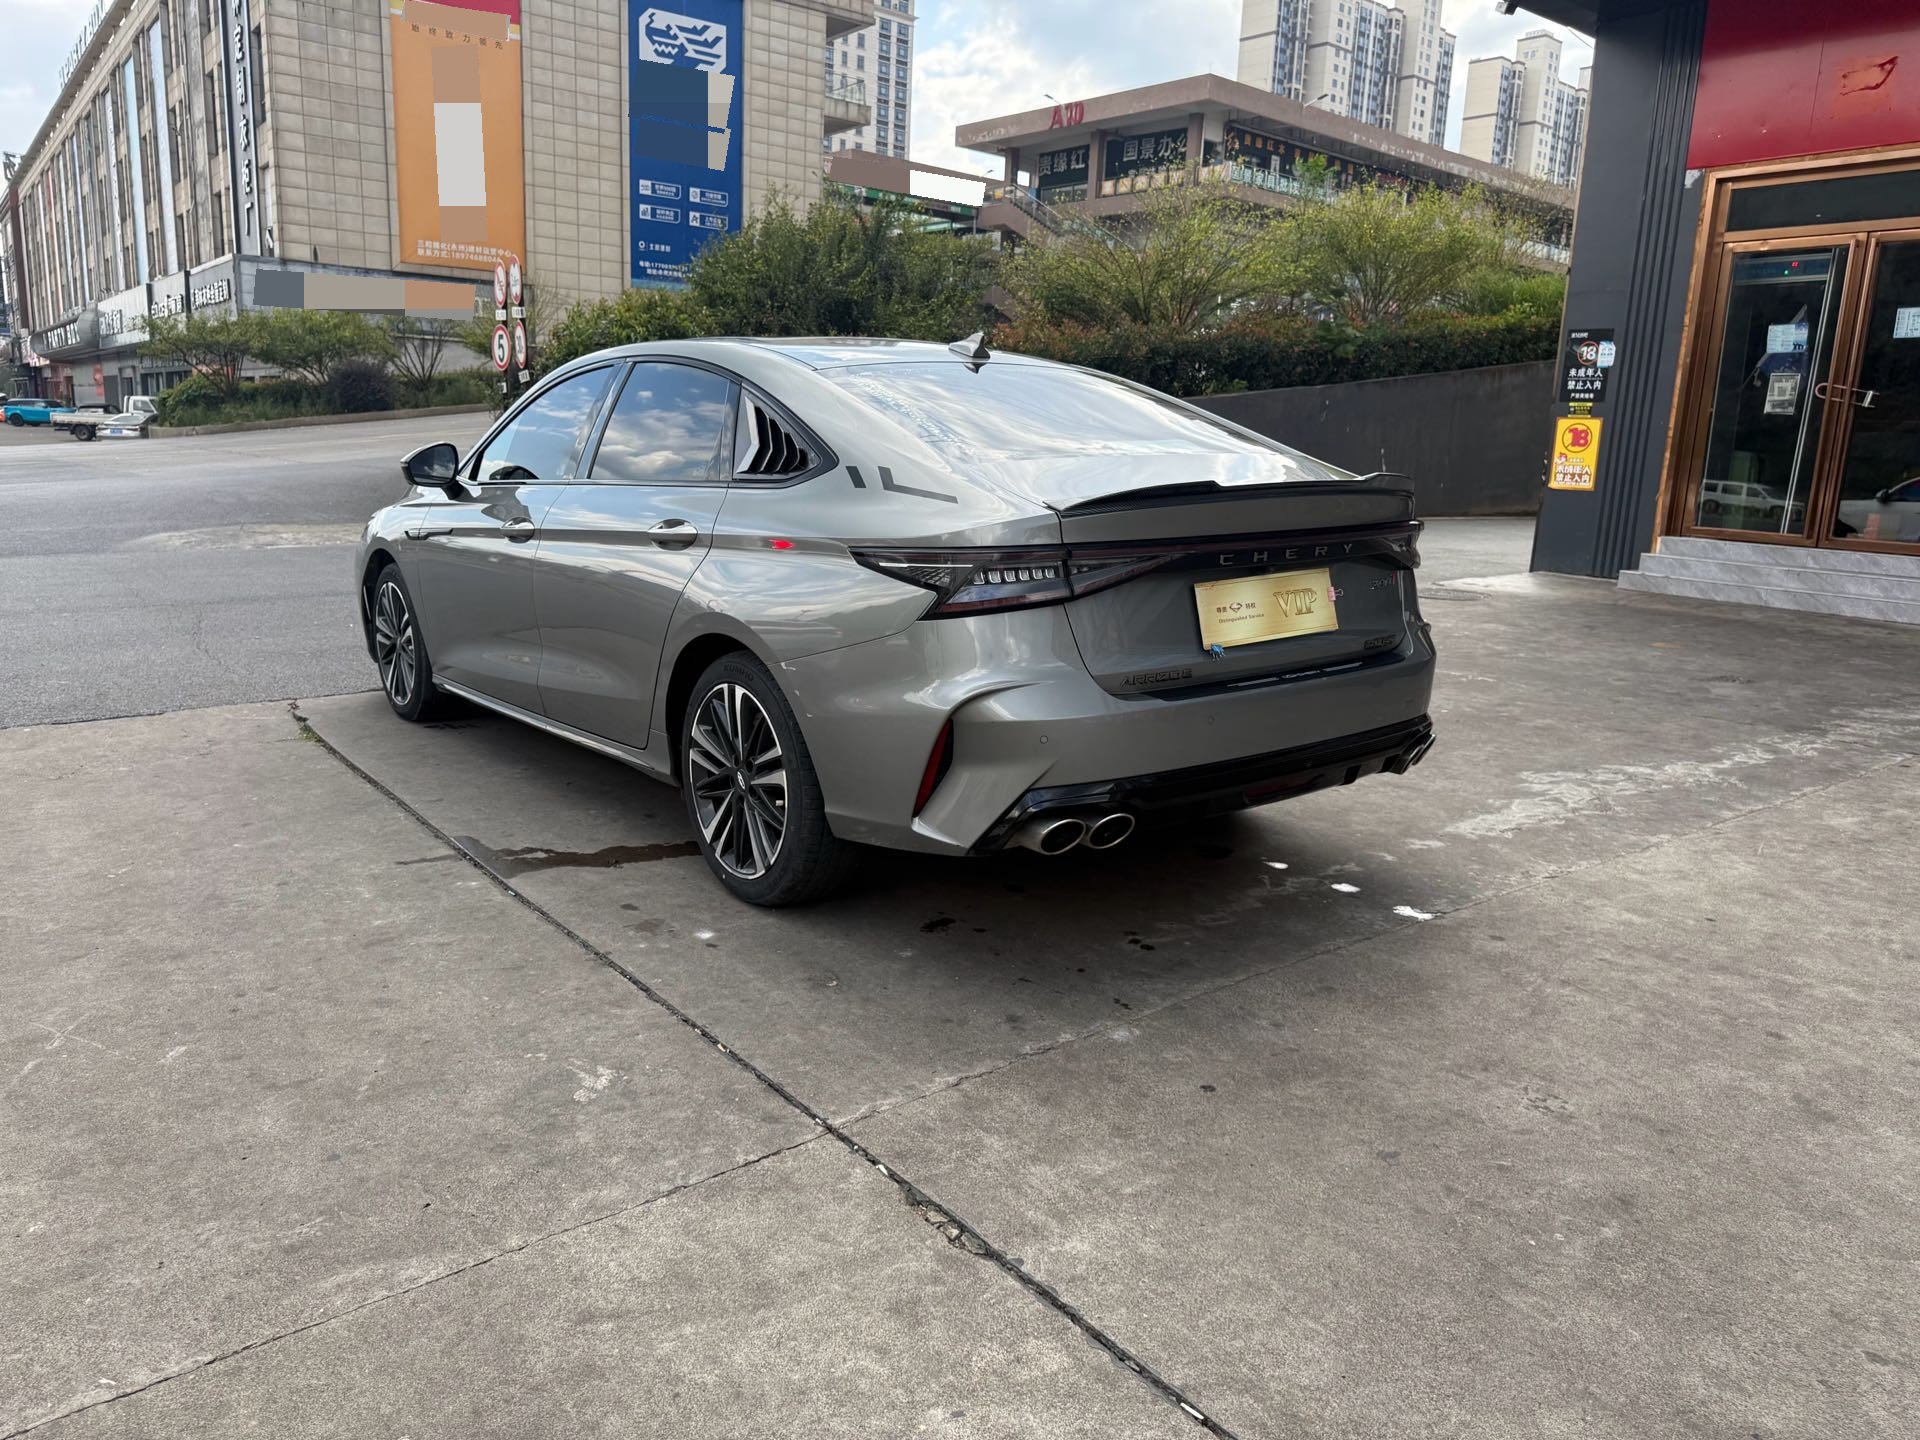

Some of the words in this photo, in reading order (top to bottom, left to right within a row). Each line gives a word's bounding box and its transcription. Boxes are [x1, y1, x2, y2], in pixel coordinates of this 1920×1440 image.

[498, 334, 505, 363] 5
[1580, 346, 1597, 360] 18
[1568, 367, 1603, 377] 未成年人
[1567, 380, 1602, 390] 禁止入内
[1568, 428, 1590, 448] 18
[1556, 465, 1591, 475] 未成年人
[1556, 474, 1590, 483] 禁止入内
[1219, 543, 1353, 566] CHERY
[1273, 587, 1318, 618] VIP
[1218, 615, 1248, 623] Distinguished
[1121, 669, 1181, 687] ARRIZO
